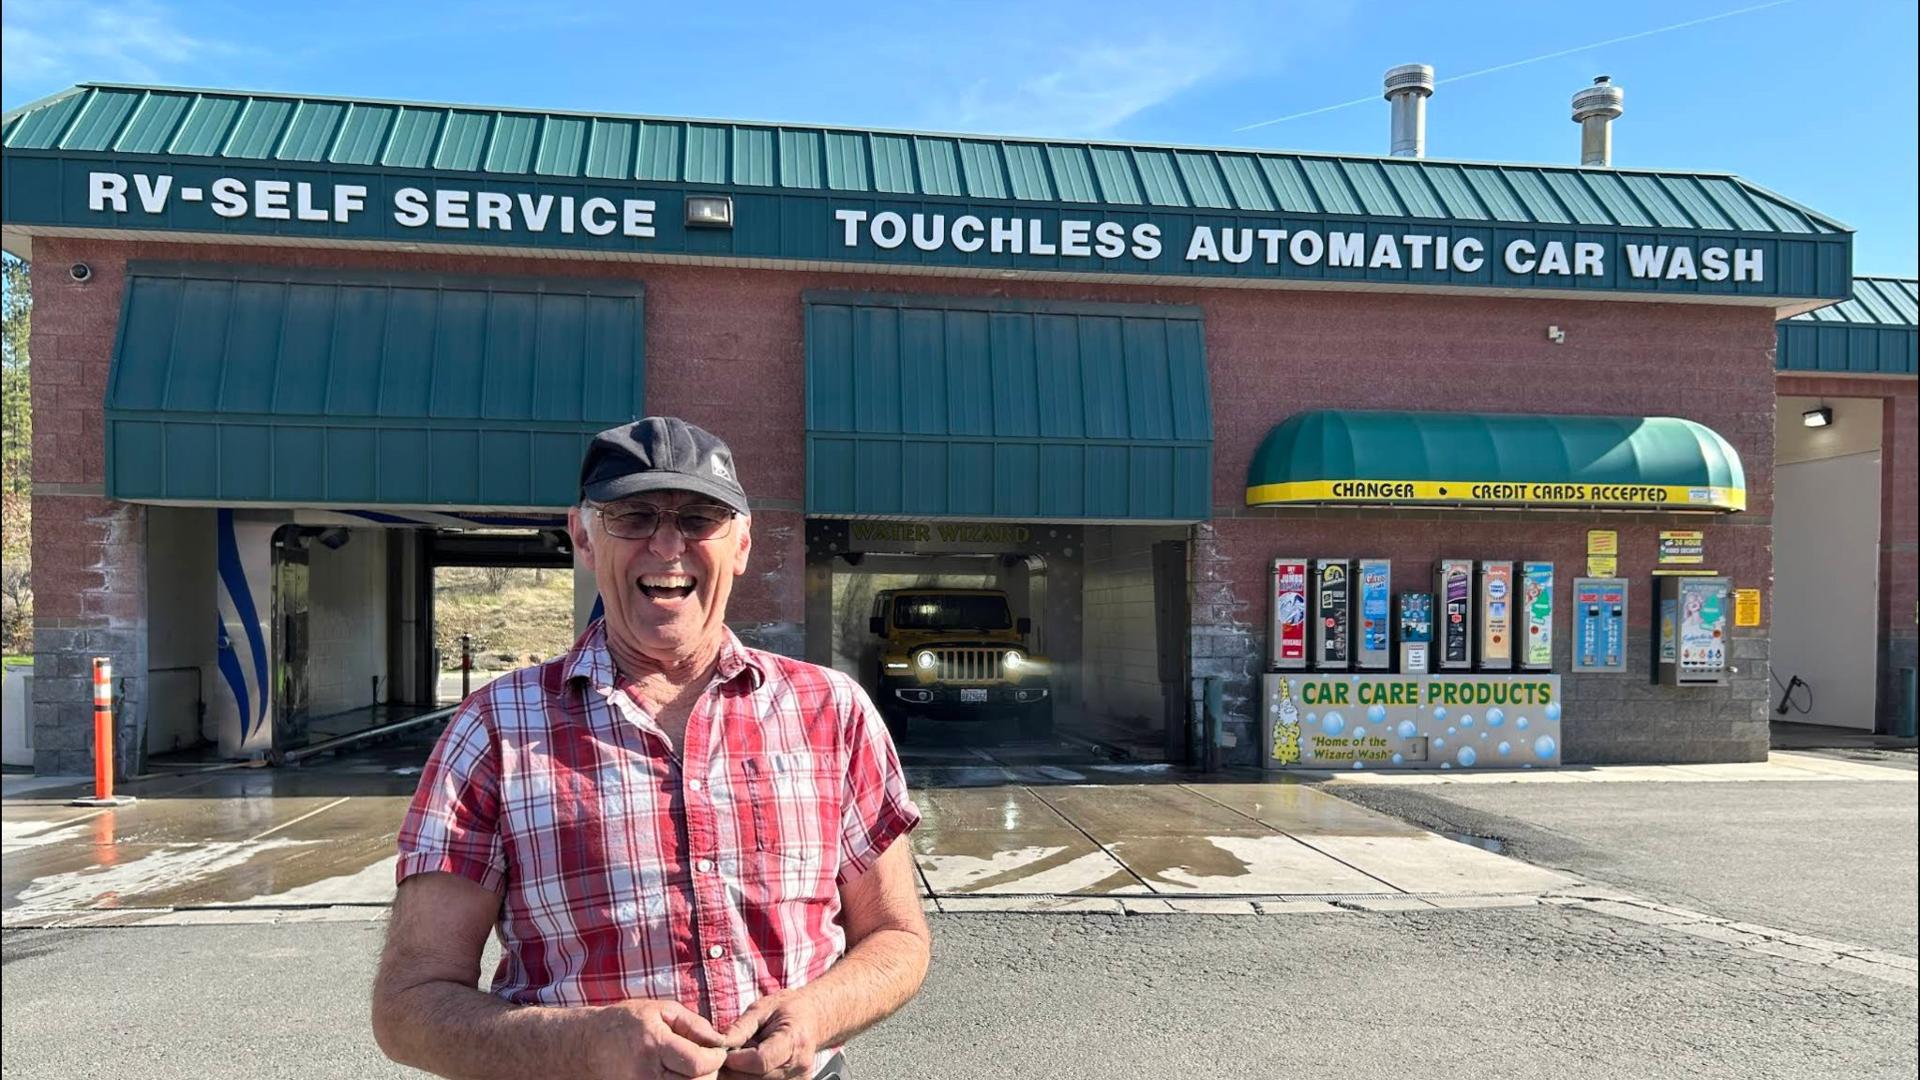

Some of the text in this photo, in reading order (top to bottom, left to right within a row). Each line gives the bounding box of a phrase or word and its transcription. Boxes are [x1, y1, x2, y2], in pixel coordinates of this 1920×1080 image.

[89, 172, 657, 238] RV-SELF SERVICE
[835, 209, 1765, 283] TOUCHLESS AUTOMATIC CAR WASH
[1332, 482, 1667, 503] CHANGER CREDIT CARDS ACCEPTED
[852, 522, 1034, 543] WATER WIZARD
[1302, 682, 1551, 705] CAR CARE PRODUCTS
[1312, 736, 1387, 747] "Home of the
[1314, 748, 1393, 759] Wizard Wash"
